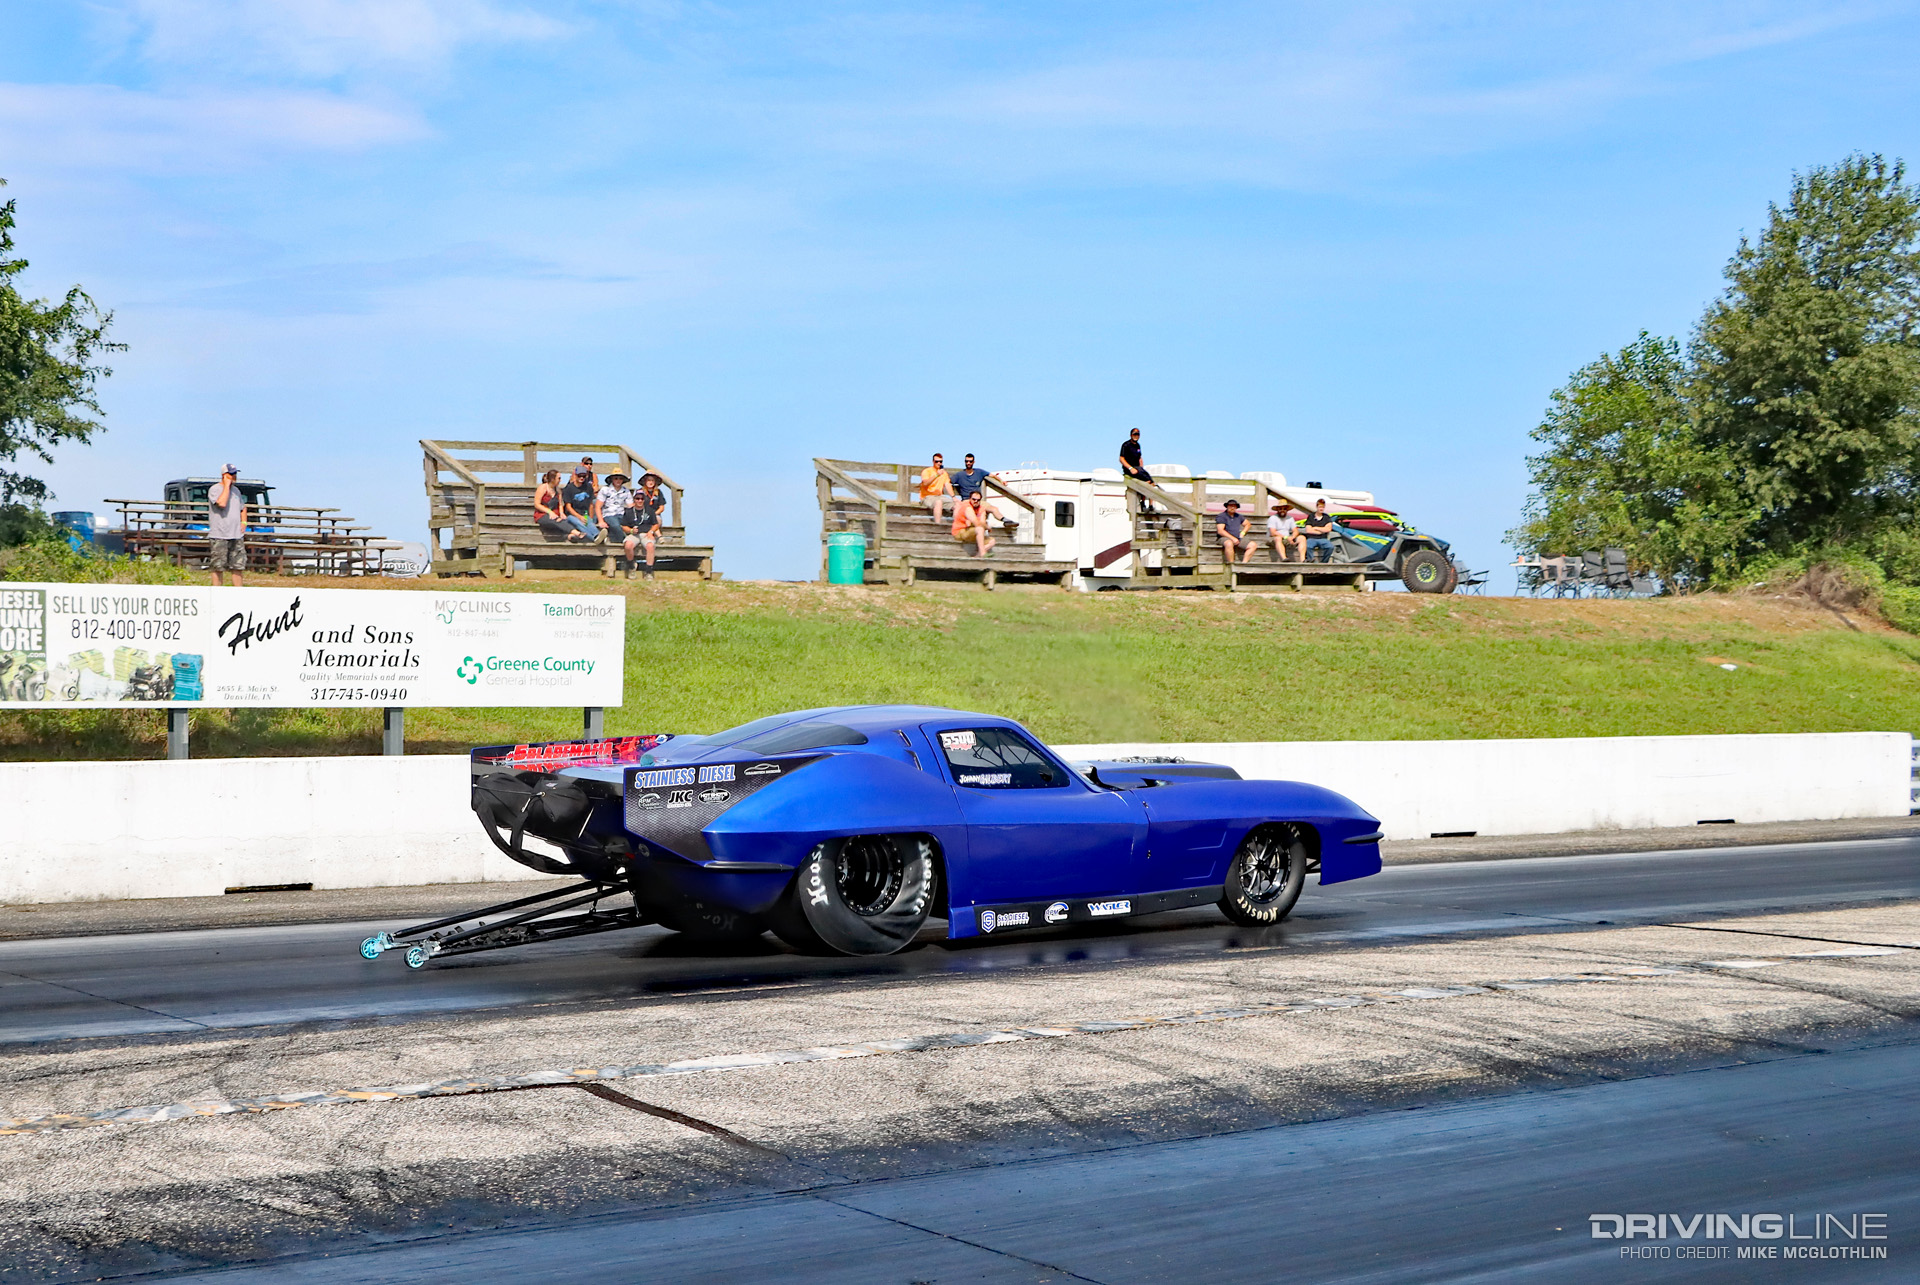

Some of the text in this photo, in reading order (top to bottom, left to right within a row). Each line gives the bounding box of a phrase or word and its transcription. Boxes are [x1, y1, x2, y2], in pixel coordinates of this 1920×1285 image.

[378, 561, 420, 571] rowler
[53, 596, 198, 617] SELL US YOUR CORES
[71, 619, 181, 640] 812-400-0782
[218, 595, 304, 656] Hunt
[312, 625, 414, 644] and Sons
[303, 649, 420, 668] Memorials
[486, 656, 595, 674] Greene County
[299, 672, 419, 682] Quality Memorials and more
[486, 673, 572, 687] General Hospital
[248, 685, 268, 693] Main
[310, 688, 408, 701] 317-745-0940
[635, 764, 736, 788] STAINLESS DIESEL
[669, 790, 693, 803] JKC
[1236, 895, 1279, 923] Hoosier
